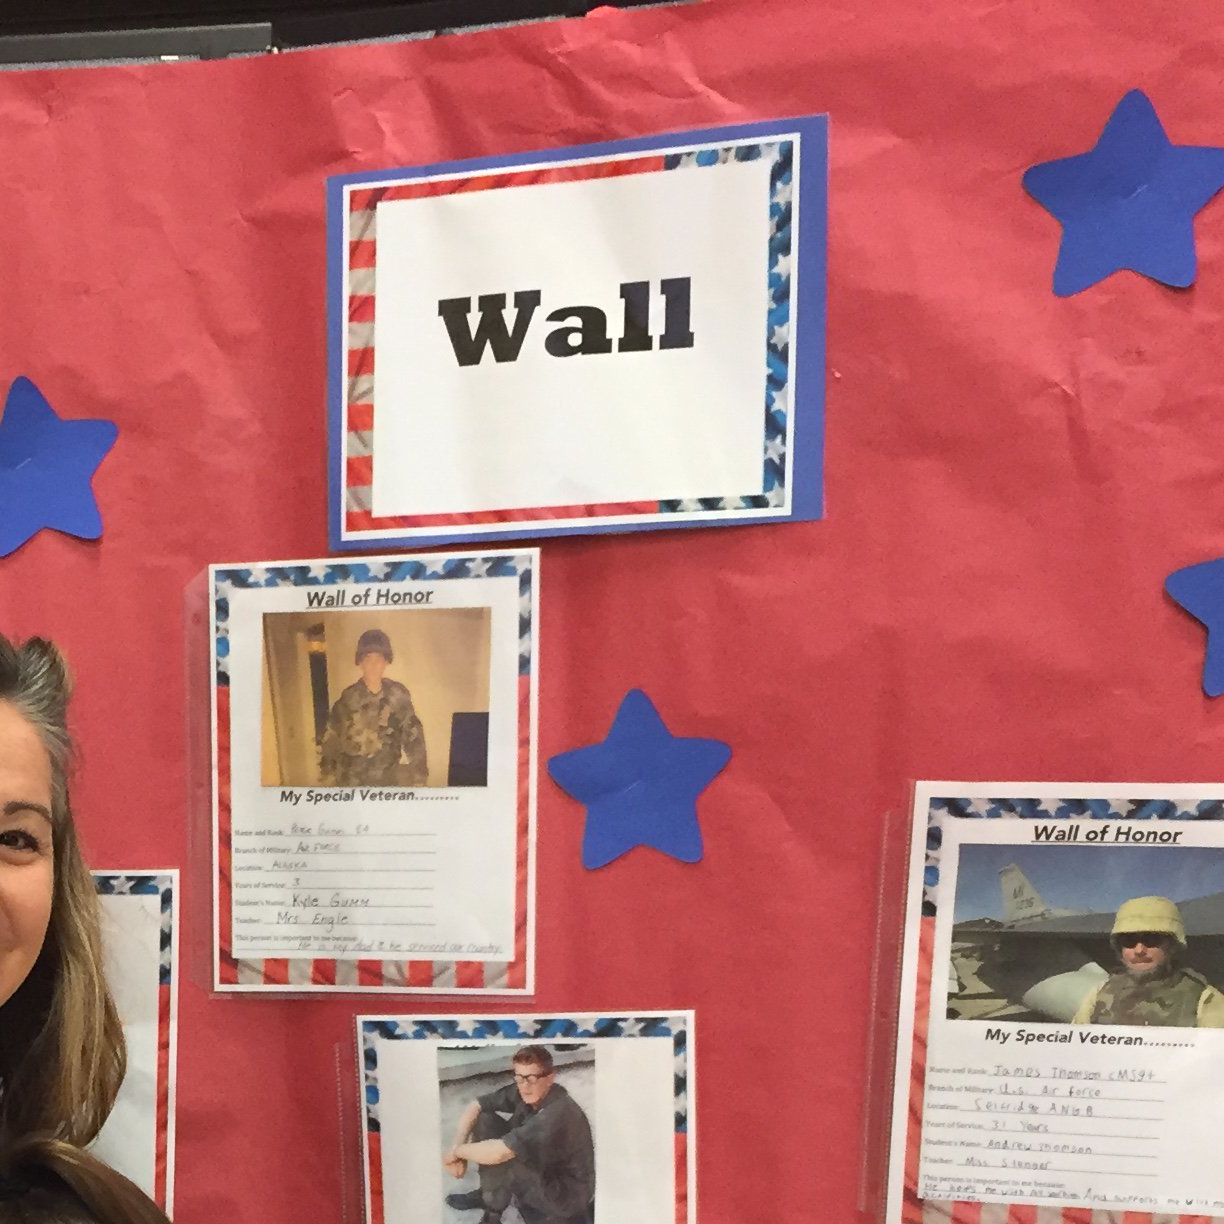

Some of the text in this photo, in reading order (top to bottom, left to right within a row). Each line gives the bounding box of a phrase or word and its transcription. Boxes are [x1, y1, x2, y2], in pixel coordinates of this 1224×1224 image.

[438, 277, 694, 367] Wall
[307, 588, 433, 607] Wall of Honor
[280, 791, 302, 805] My
[307, 790, 354, 804] Special
[1034, 823, 1182, 843] Wall of Honor
[276, 912, 349, 932] Mrs Engle
[985, 1029, 1010, 1044] My
[1015, 1030, 1073, 1045] Special
[993, 1065, 1040, 1078] James
